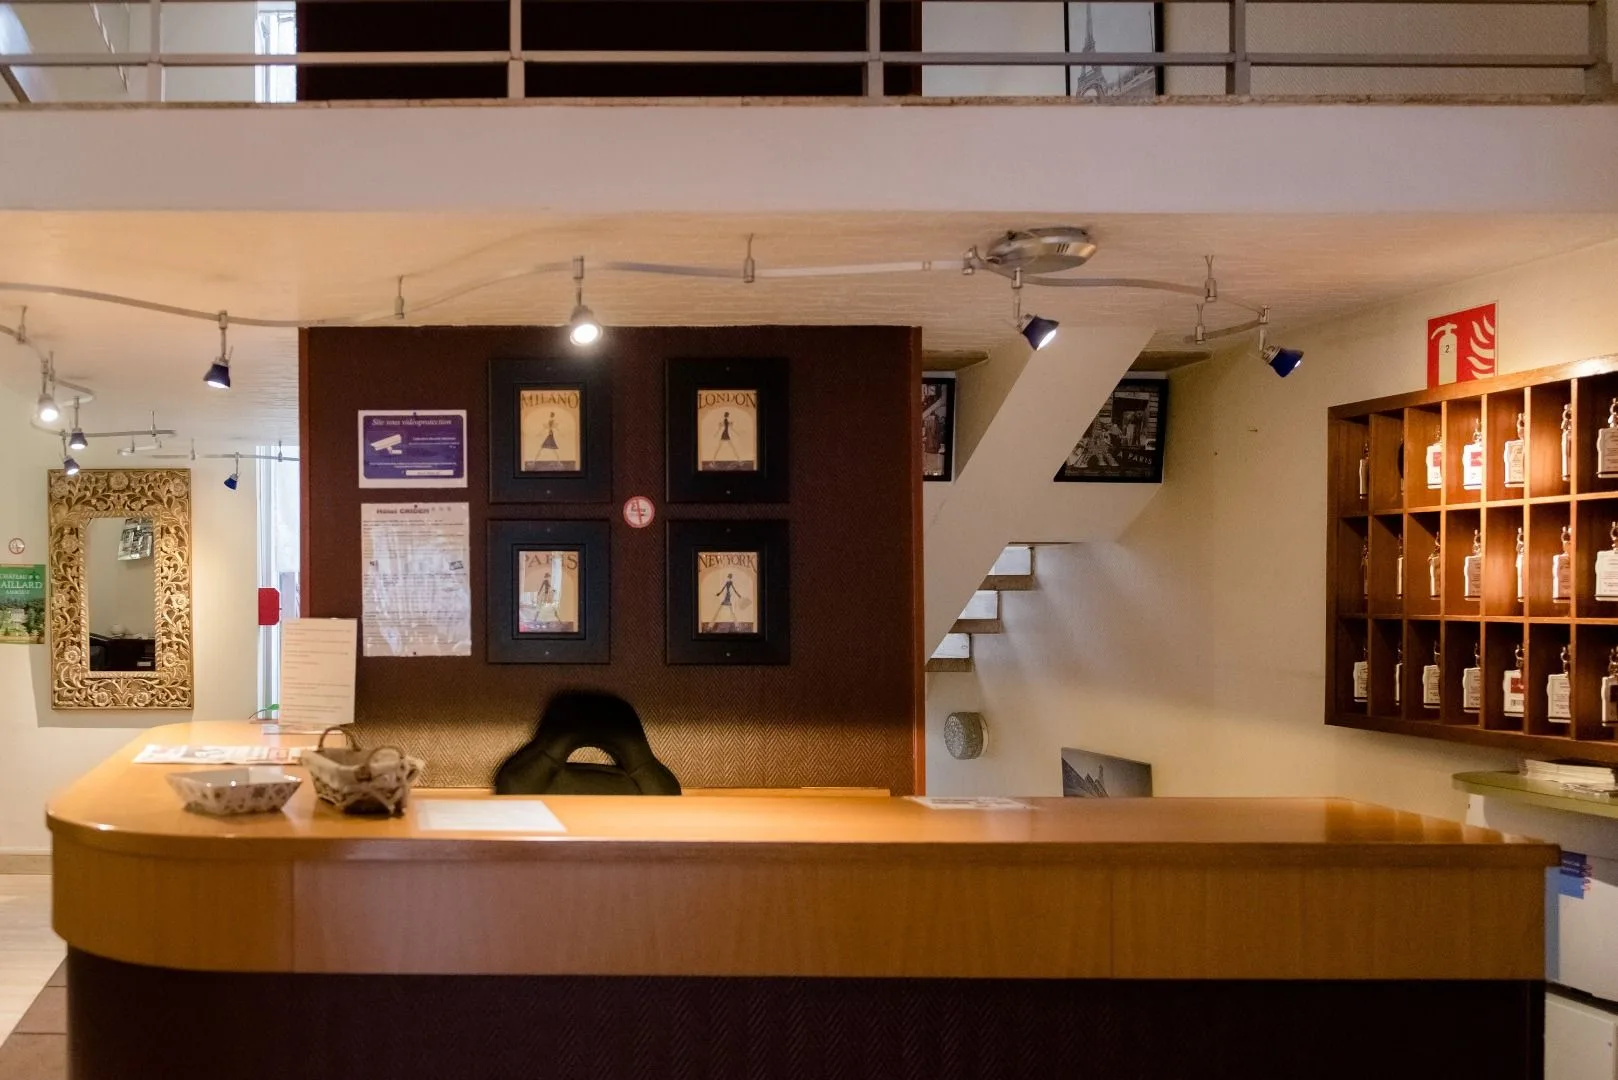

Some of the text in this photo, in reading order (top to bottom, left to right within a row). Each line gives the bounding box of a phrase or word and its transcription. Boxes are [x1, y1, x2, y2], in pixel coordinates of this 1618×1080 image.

[1445, 344, 1450, 354] 2
[521, 391, 579, 409] MILANO
[698, 391, 757, 409] LONDON
[726, 553, 757, 572] YORK
[0, 580, 43, 589] AILLARD
